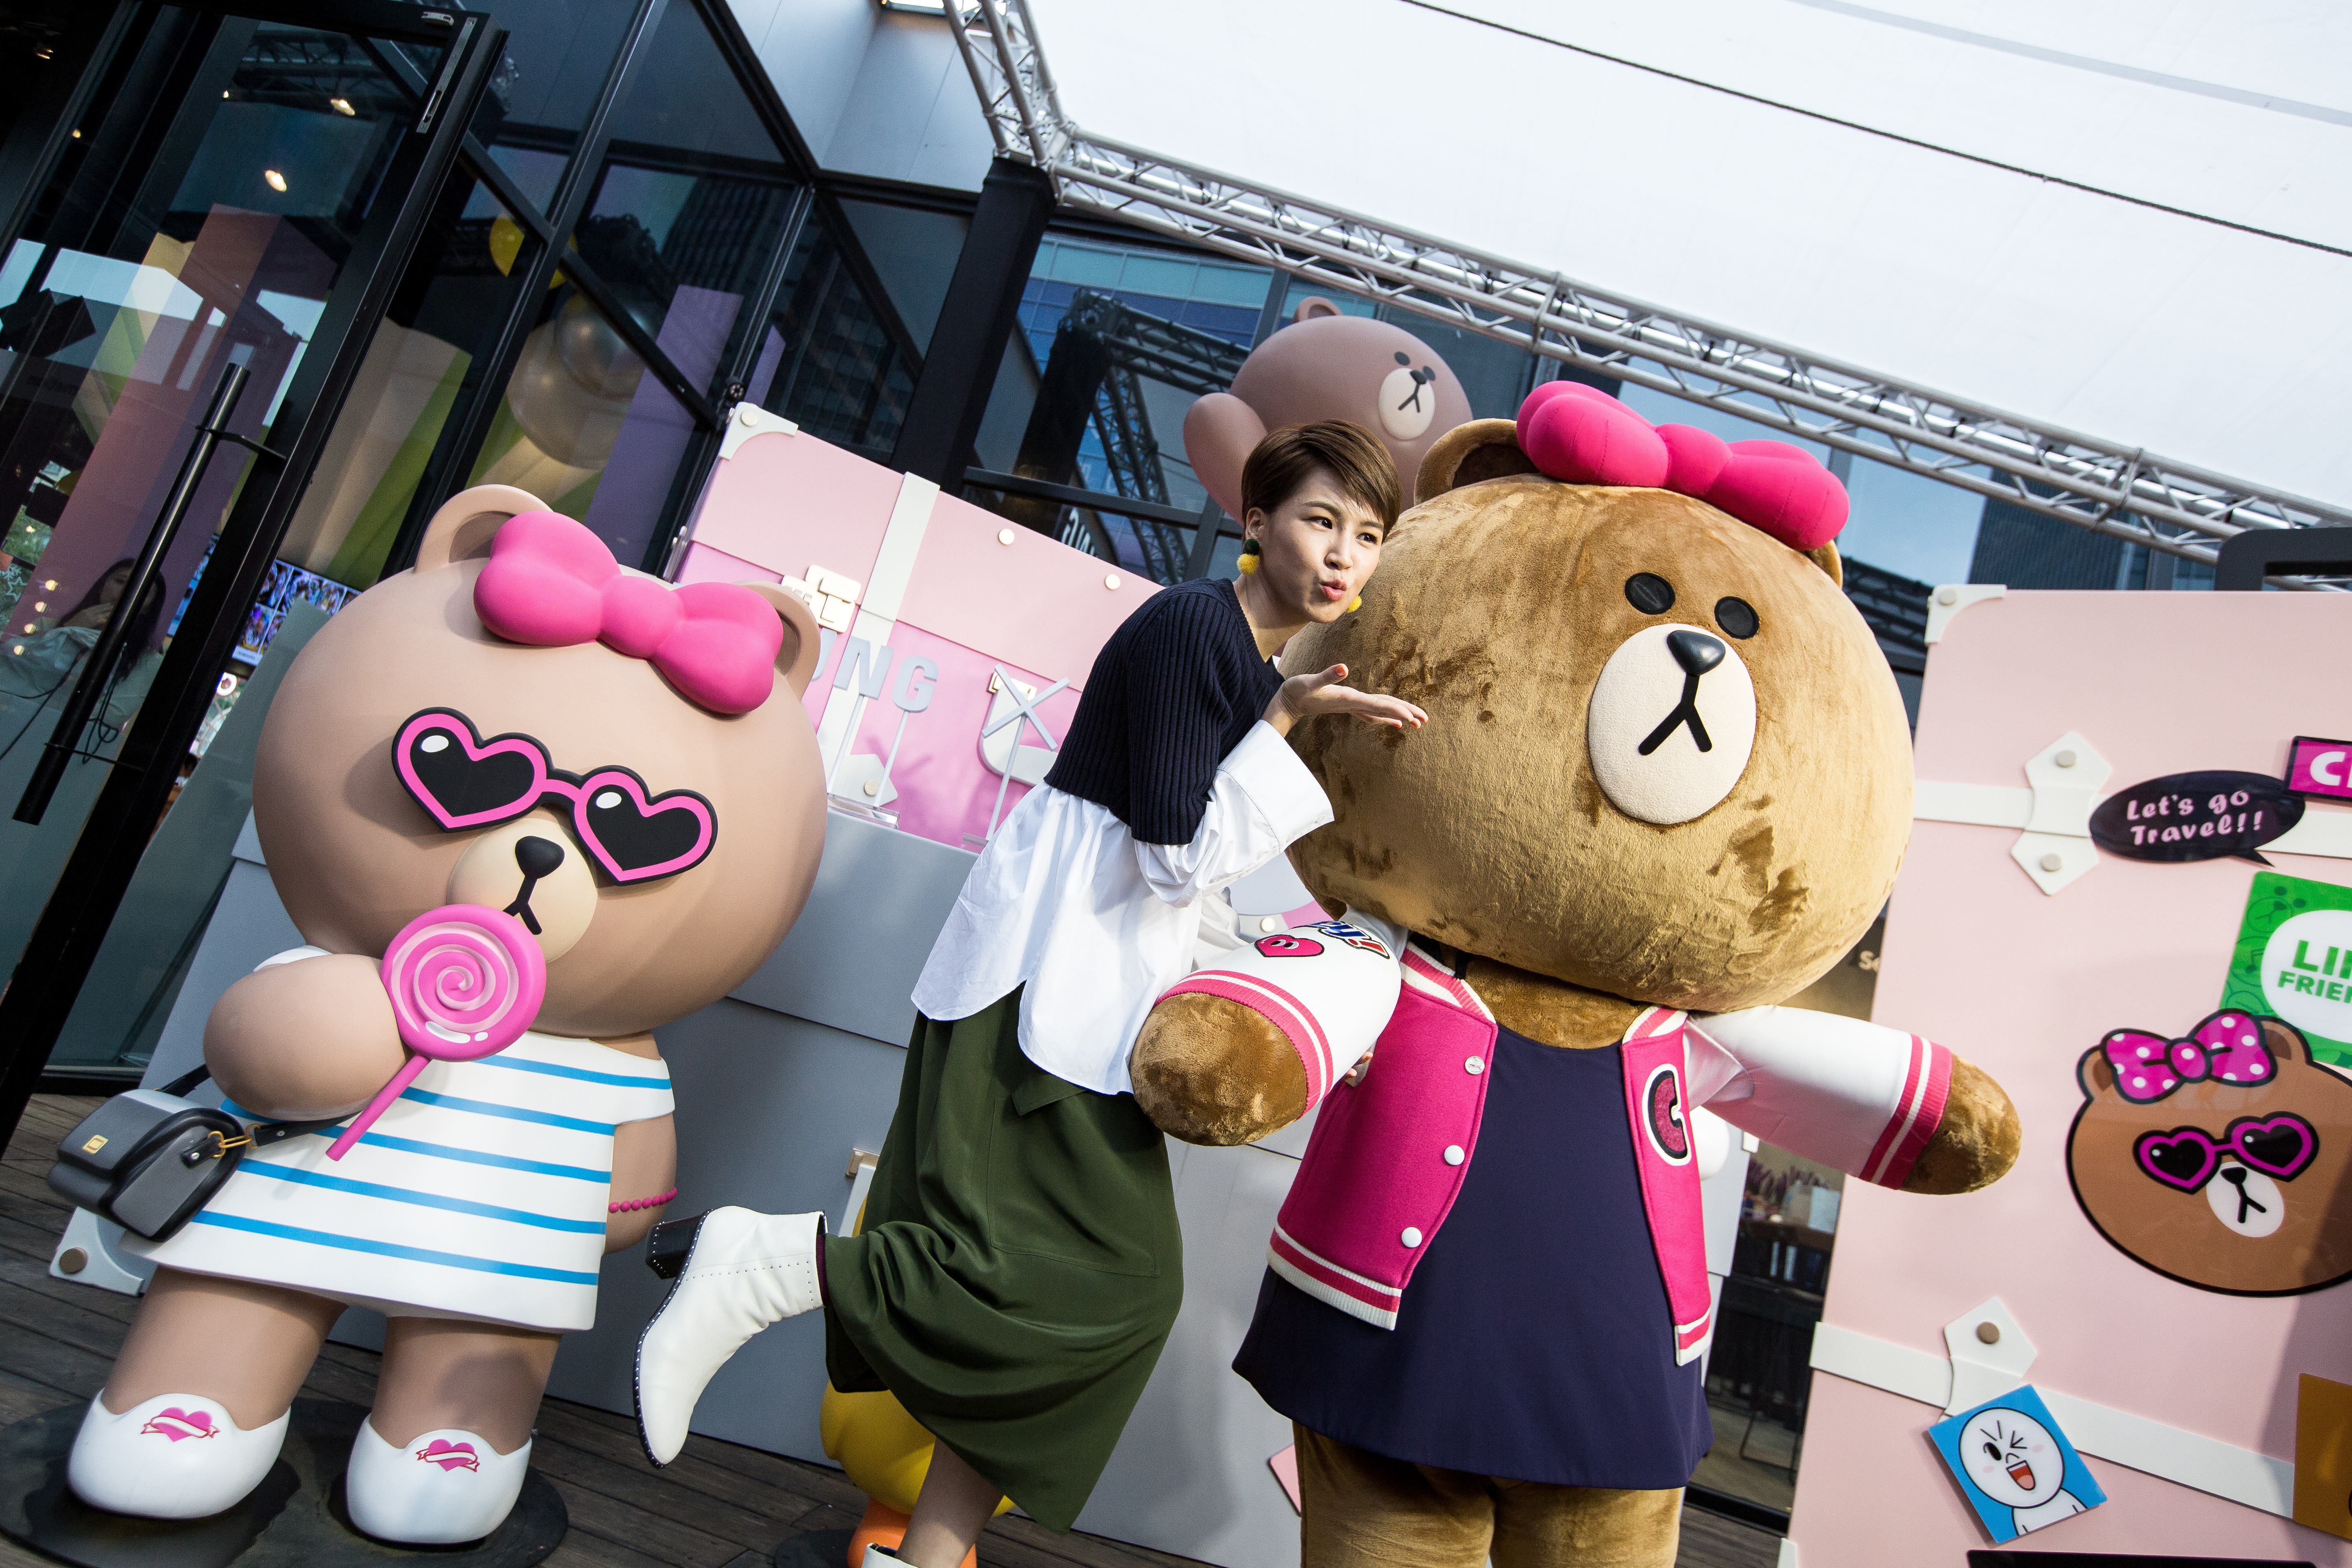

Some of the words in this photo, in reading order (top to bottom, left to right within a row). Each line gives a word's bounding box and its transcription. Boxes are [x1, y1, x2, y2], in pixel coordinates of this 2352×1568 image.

[2126, 794, 2195, 821] Let's
[2208, 790, 2250, 815] go
[2130, 811, 2264, 846] Travel!!
